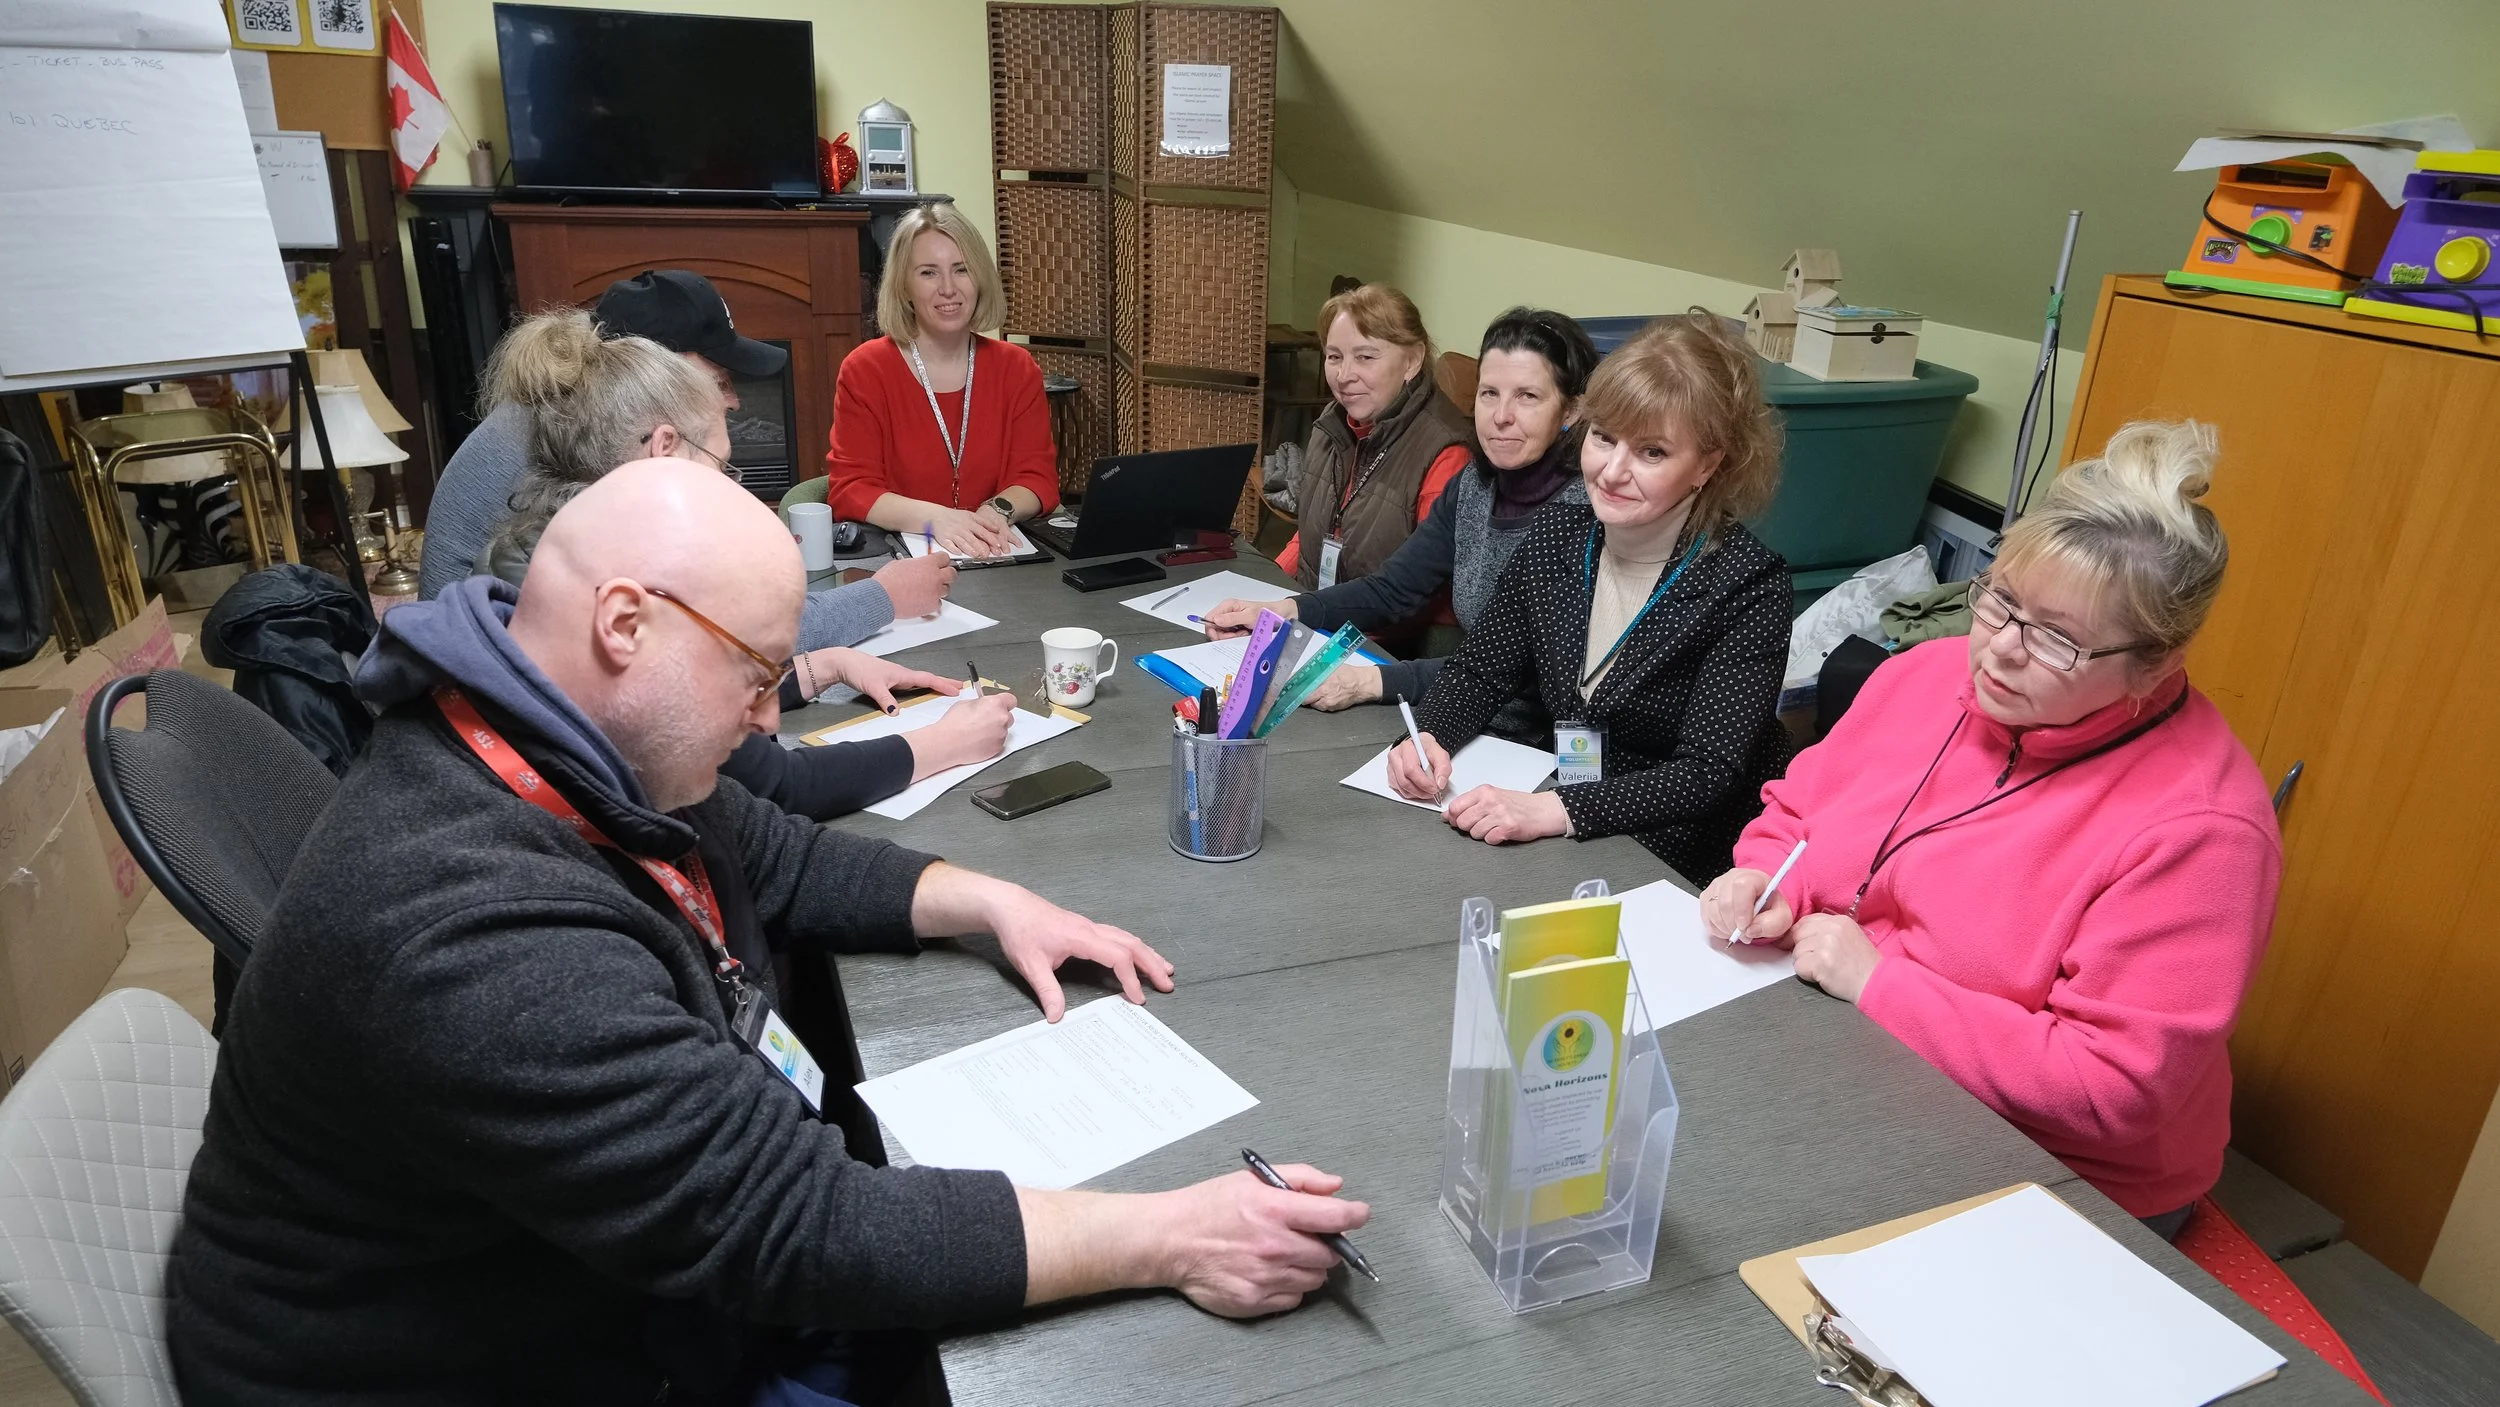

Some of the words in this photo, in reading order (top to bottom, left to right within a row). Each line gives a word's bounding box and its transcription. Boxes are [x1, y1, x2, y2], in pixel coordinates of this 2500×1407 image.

[27, 55, 81, 67] TICKET
[131, 57, 164, 70] PASS
[51, 113, 139, 135] QUEBEC
[1561, 772, 1598, 780] Valeriia
[1555, 1072, 1608, 1088] Horizons
